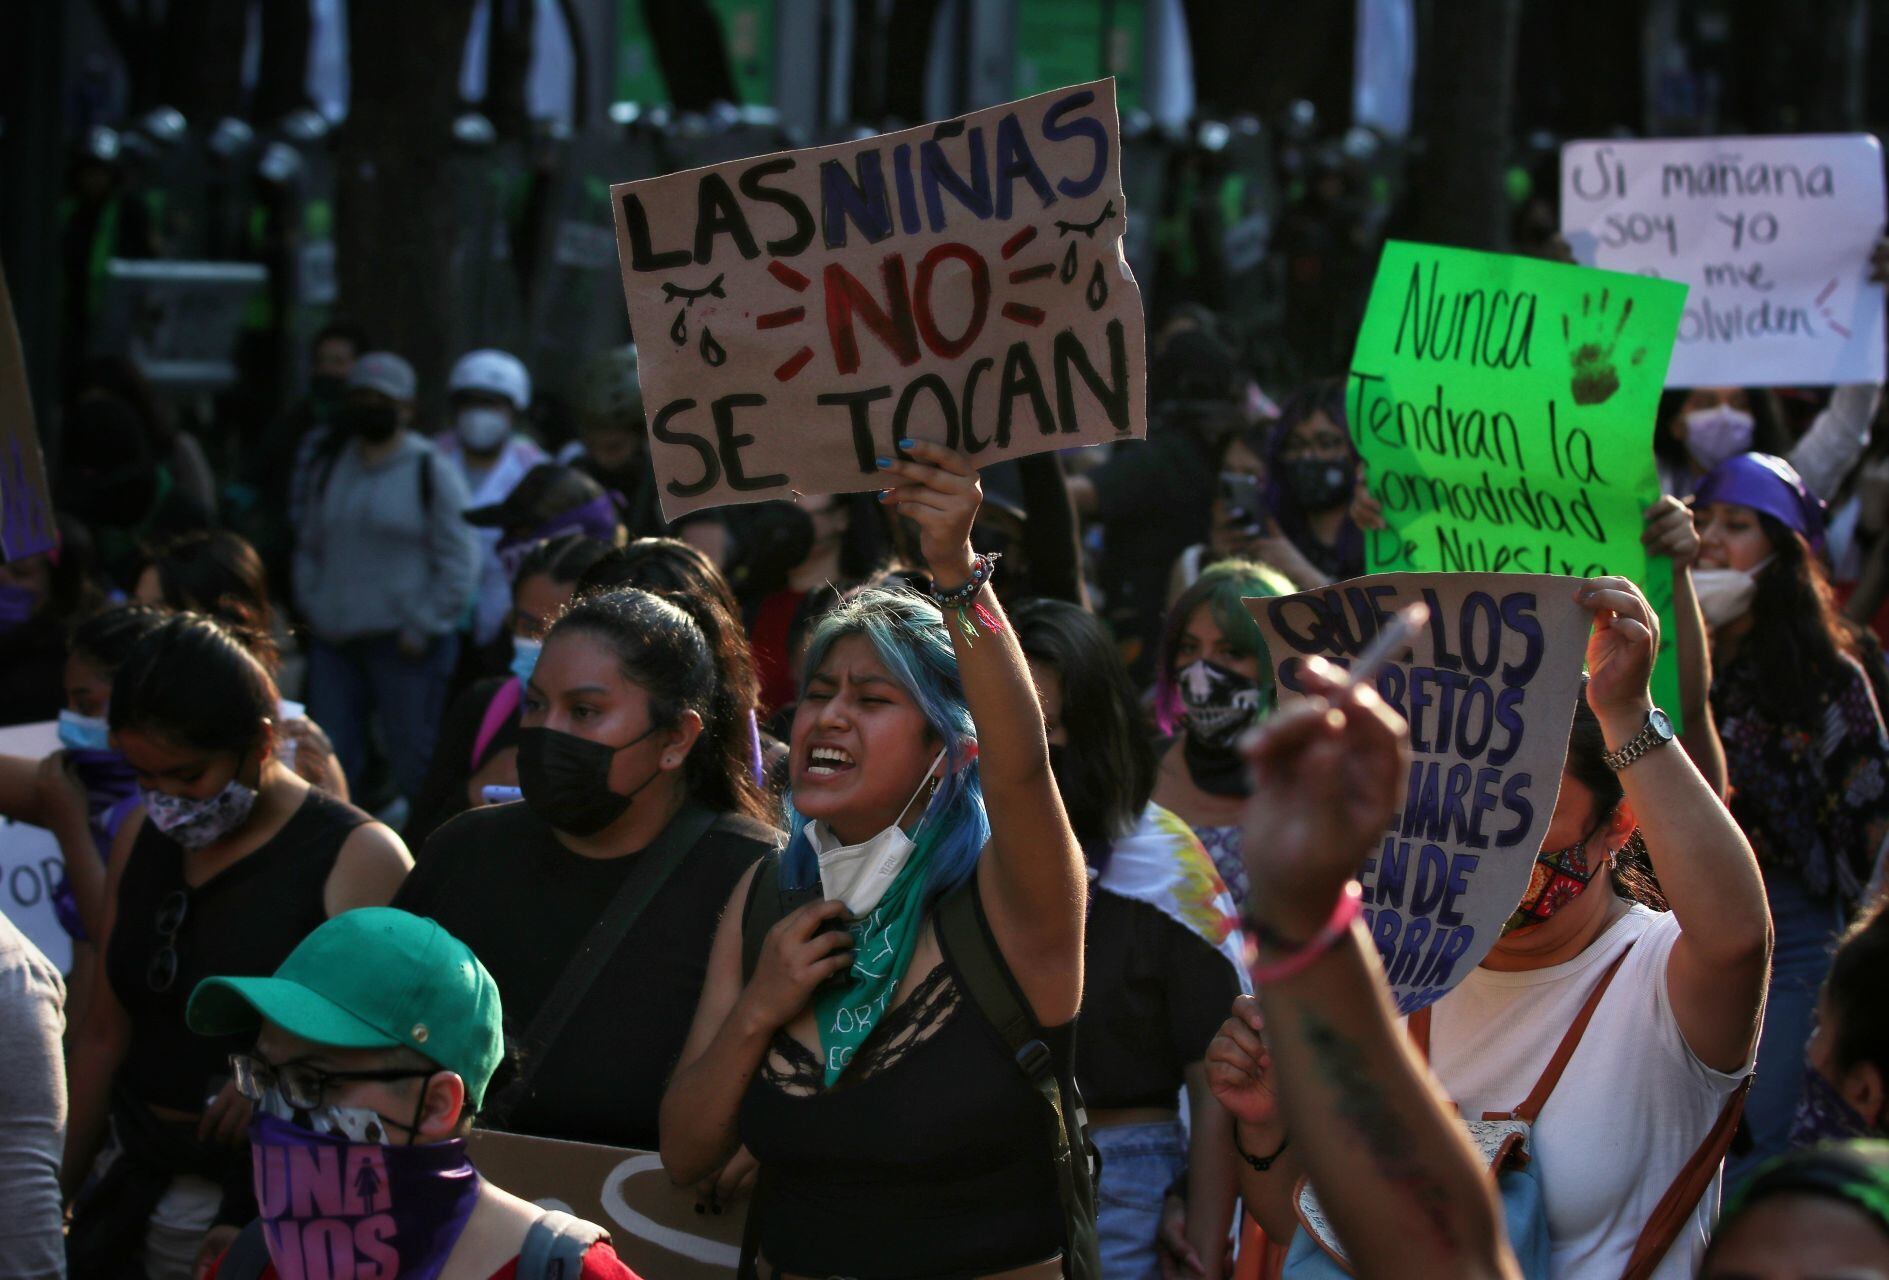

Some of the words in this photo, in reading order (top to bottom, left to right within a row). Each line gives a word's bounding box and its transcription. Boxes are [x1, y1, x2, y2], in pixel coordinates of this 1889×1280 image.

[621, 156, 816, 273] LAS
[819, 91, 1110, 250] NIÑAS
[1661, 152, 1835, 199] mañana
[1602, 212, 1677, 256] soy
[823, 242, 992, 375] NO
[1394, 260, 1537, 370] Nunca
[1702, 262, 1775, 292] me
[1677, 297, 1818, 344] olviden
[652, 393, 790, 497] SE
[816, 318, 1132, 475] TOCAN
[1348, 371, 1525, 471] Tendran
[1548, 401, 1605, 486] la
[1371, 470, 1606, 544] omodidad
[1267, 585, 1414, 664] QUE
[1422, 588, 1544, 689] LOS
[1409, 843, 1480, 927] DE
[251, 1143, 393, 1219] UNA
